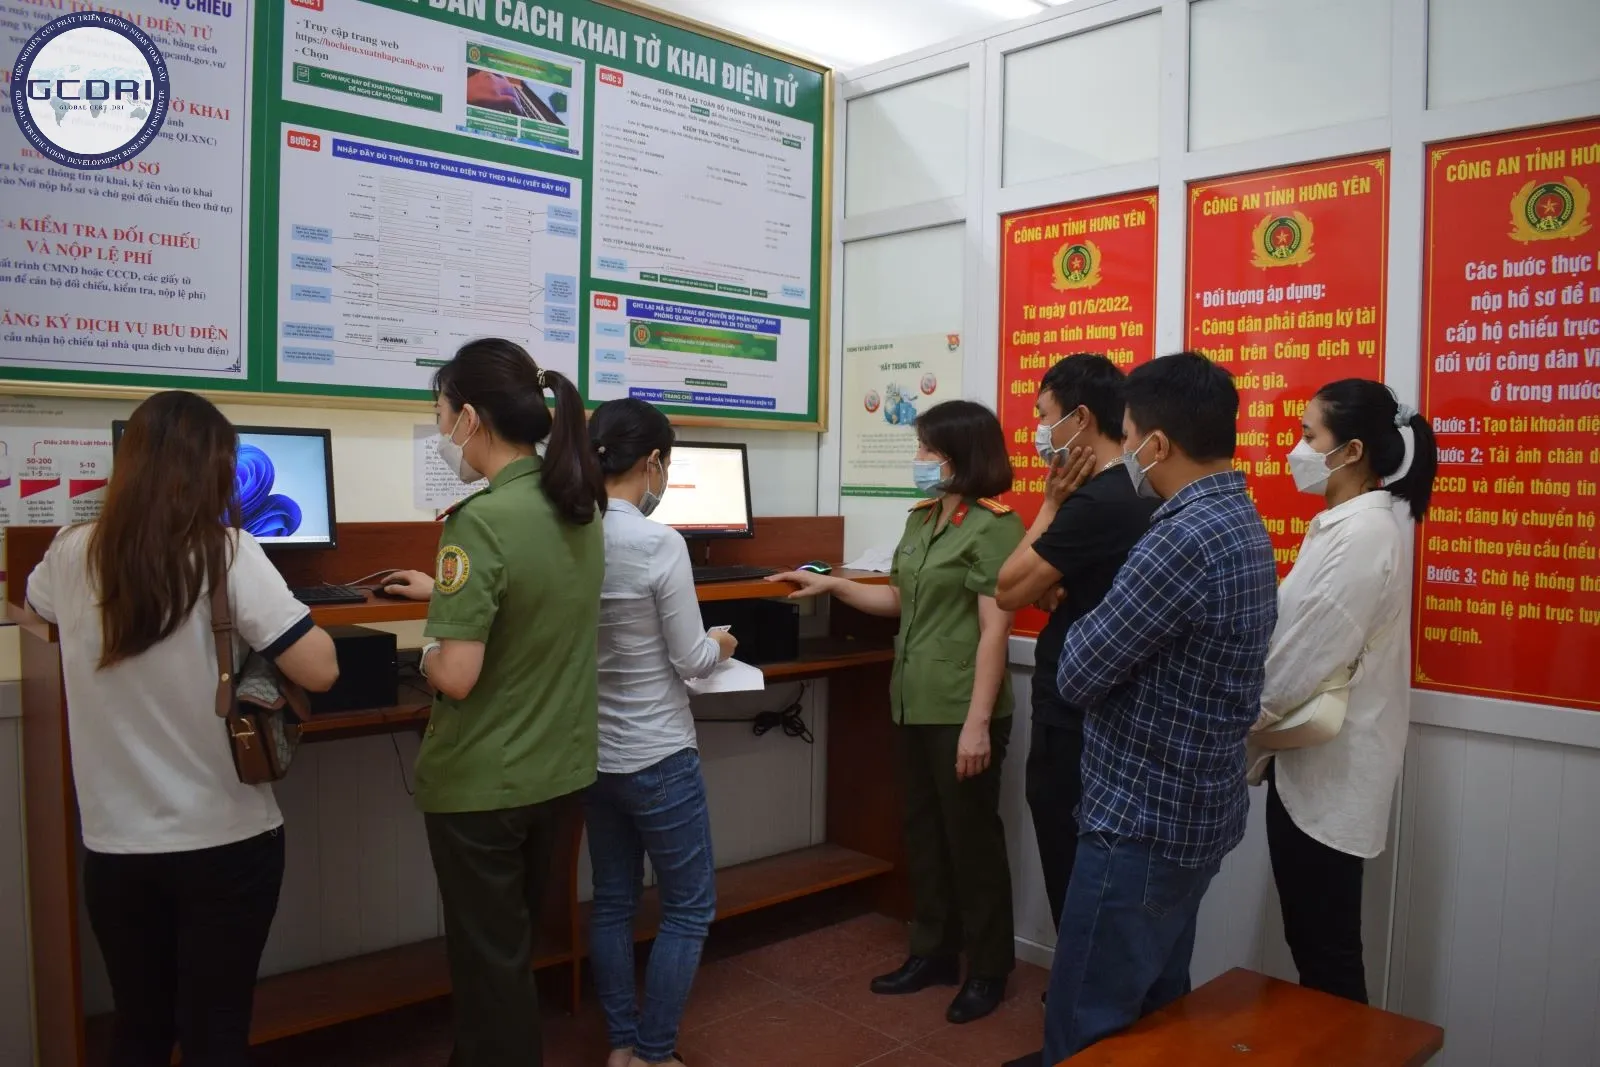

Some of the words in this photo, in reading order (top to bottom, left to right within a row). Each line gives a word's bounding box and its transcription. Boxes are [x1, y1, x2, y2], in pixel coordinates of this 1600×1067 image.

[146, 16, 186, 36] ĐIỆN
[191, 24, 213, 40] TỬ
[304, 19, 328, 33] Truy
[332, 28, 348, 39] cập
[352, 33, 377, 46] trang
[381, 40, 399, 49] web
[302, 47, 328, 61] Chọn
[572, 18, 627, 59] KHAI
[634, 34, 661, 69] TỜ
[667, 45, 716, 85] KHAI
[722, 62, 768, 101] ĐIỆN
[774, 73, 800, 108] TỬ
[190, 103, 230, 120] KHAI
[311, 139, 318, 148] 2
[389, 154, 413, 165] THÔNG
[416, 159, 428, 167] TIN
[441, 164, 458, 172] KHAI
[489, 173, 505, 181] THEO
[1446, 160, 1491, 182] CÔNG
[1497, 155, 1520, 176] AN
[1526, 146, 1565, 172] TỈNH
[1203, 196, 1237, 216] CÔNG
[1242, 193, 1260, 210] AN
[1265, 185, 1295, 208] TỈNH
[1299, 182, 1337, 201] HƯNG
[1342, 176, 1370, 196] YÊN
[20, 215, 67, 235] KIỂM
[73, 223, 108, 240] TRA
[114, 224, 144, 243] ĐỐI
[149, 232, 200, 250] CHIẾU
[1014, 227, 1041, 244] CÔNG
[1045, 224, 1059, 239] AN
[1063, 218, 1086, 237] TỈNH
[1090, 216, 1120, 232] HƯNG
[1124, 210, 1145, 227] YÊN
[27, 238, 50, 255] VÀ
[56, 243, 92, 262] NỘP
[98, 246, 119, 264] LỆ
[124, 249, 153, 264] PHÍ
[107, 269, 141, 282] CCCD,
[1466, 261, 1497, 281] Các
[1503, 256, 1546, 278] bước
[1552, 254, 1591, 277] thực
[1203, 287, 1222, 307] Đối
[1227, 288, 1264, 307] tượng
[1267, 284, 1284, 303] áp
[1286, 283, 1326, 303] dụng:
[1471, 291, 1502, 313] nộp
[1508, 285, 1529, 308] hồ
[1535, 288, 1556, 306] sơ
[1562, 282, 1583, 304] đề
[1023, 304, 1035, 319] Từ
[1039, 303, 1065, 319] ngày
[1202, 318, 1234, 336] Công
[1238, 316, 1261, 333] dân
[1265, 311, 1294, 333] phải
[1298, 311, 1333, 329] đăng
[1336, 307, 1352, 328] ký
[1357, 306, 1376, 324] tài
[2, 309, 39, 327] ĂNG
[46, 313, 71, 329] KÝ
[76, 317, 119, 336] DỊCH
[125, 321, 147, 338] VỤ
[152, 324, 186, 337] BƯU
[190, 325, 229, 342] ĐIỆN
[1013, 330, 1040, 346] Công
[1044, 331, 1057, 342] an
[1061, 325, 1082, 342] tỉnh
[1086, 323, 1116, 339] Hưng
[1120, 321, 1143, 337] Yên
[1446, 320, 1477, 344] cấp
[1482, 322, 1502, 344] hộ
[1509, 315, 1557, 339] chiếu
[1020, 350, 1045, 369] triển
[1241, 346, 1266, 361] trên
[1275, 338, 1309, 360] Cổng
[1318, 339, 1349, 360] dịch
[1358, 340, 1375, 360] vụ
[1435, 351, 1460, 373] đối
[1466, 351, 1491, 371] với
[1497, 351, 1539, 373] công
[1545, 348, 1577, 368] dân
[1011, 380, 1034, 397] dịch
[1263, 373, 1288, 389] gia.
[1491, 381, 1500, 401] ở
[1507, 381, 1552, 402] trong
[1249, 402, 1274, 417] dân
[1433, 416, 1466, 433] Bước
[1470, 418, 1480, 433] 1:
[1484, 417, 1507, 436] Tạo
[1510, 417, 1527, 433] tài
[1531, 414, 1573, 433] khoản
[1277, 429, 1293, 446] có
[1256, 455, 1280, 476] gắn
[1471, 448, 1483, 463] 2:
[1490, 446, 1509, 463] Tải
[1516, 445, 1541, 463] ảnh
[1548, 448, 1583, 464] chân
[1432, 476, 1466, 493] CCCD
[1472, 478, 1488, 494] và
[1494, 476, 1524, 494] điền
[1531, 479, 1570, 497] thông
[1577, 480, 1596, 495] tin
[1429, 507, 1462, 524] khai;
[1466, 508, 1498, 525] đăng
[1502, 509, 1518, 527] ký
[1522, 508, 1573, 528] chuyển
[1577, 512, 1595, 531] hộ
[1428, 536, 1449, 555] địa
[1451, 535, 1472, 552] chỉ
[1474, 538, 1503, 554] theo
[1507, 539, 1531, 557] yêu
[1534, 538, 1559, 557] cầu
[1563, 541, 1595, 561] (nếu
[1427, 565, 1460, 582] Bước
[1464, 568, 1477, 584] 3:
[1482, 569, 1507, 585] Chờ
[1512, 571, 1529, 590] hệ
[1535, 570, 1575, 592] thống
[1426, 596, 1462, 613] thanh
[1467, 598, 1496, 615] toán
[1501, 600, 1513, 619] lệ
[1519, 602, 1541, 620] phí
[1546, 605, 1573, 624] trực
[1425, 626, 1446, 641] quy
[1450, 625, 1482, 646] định.
